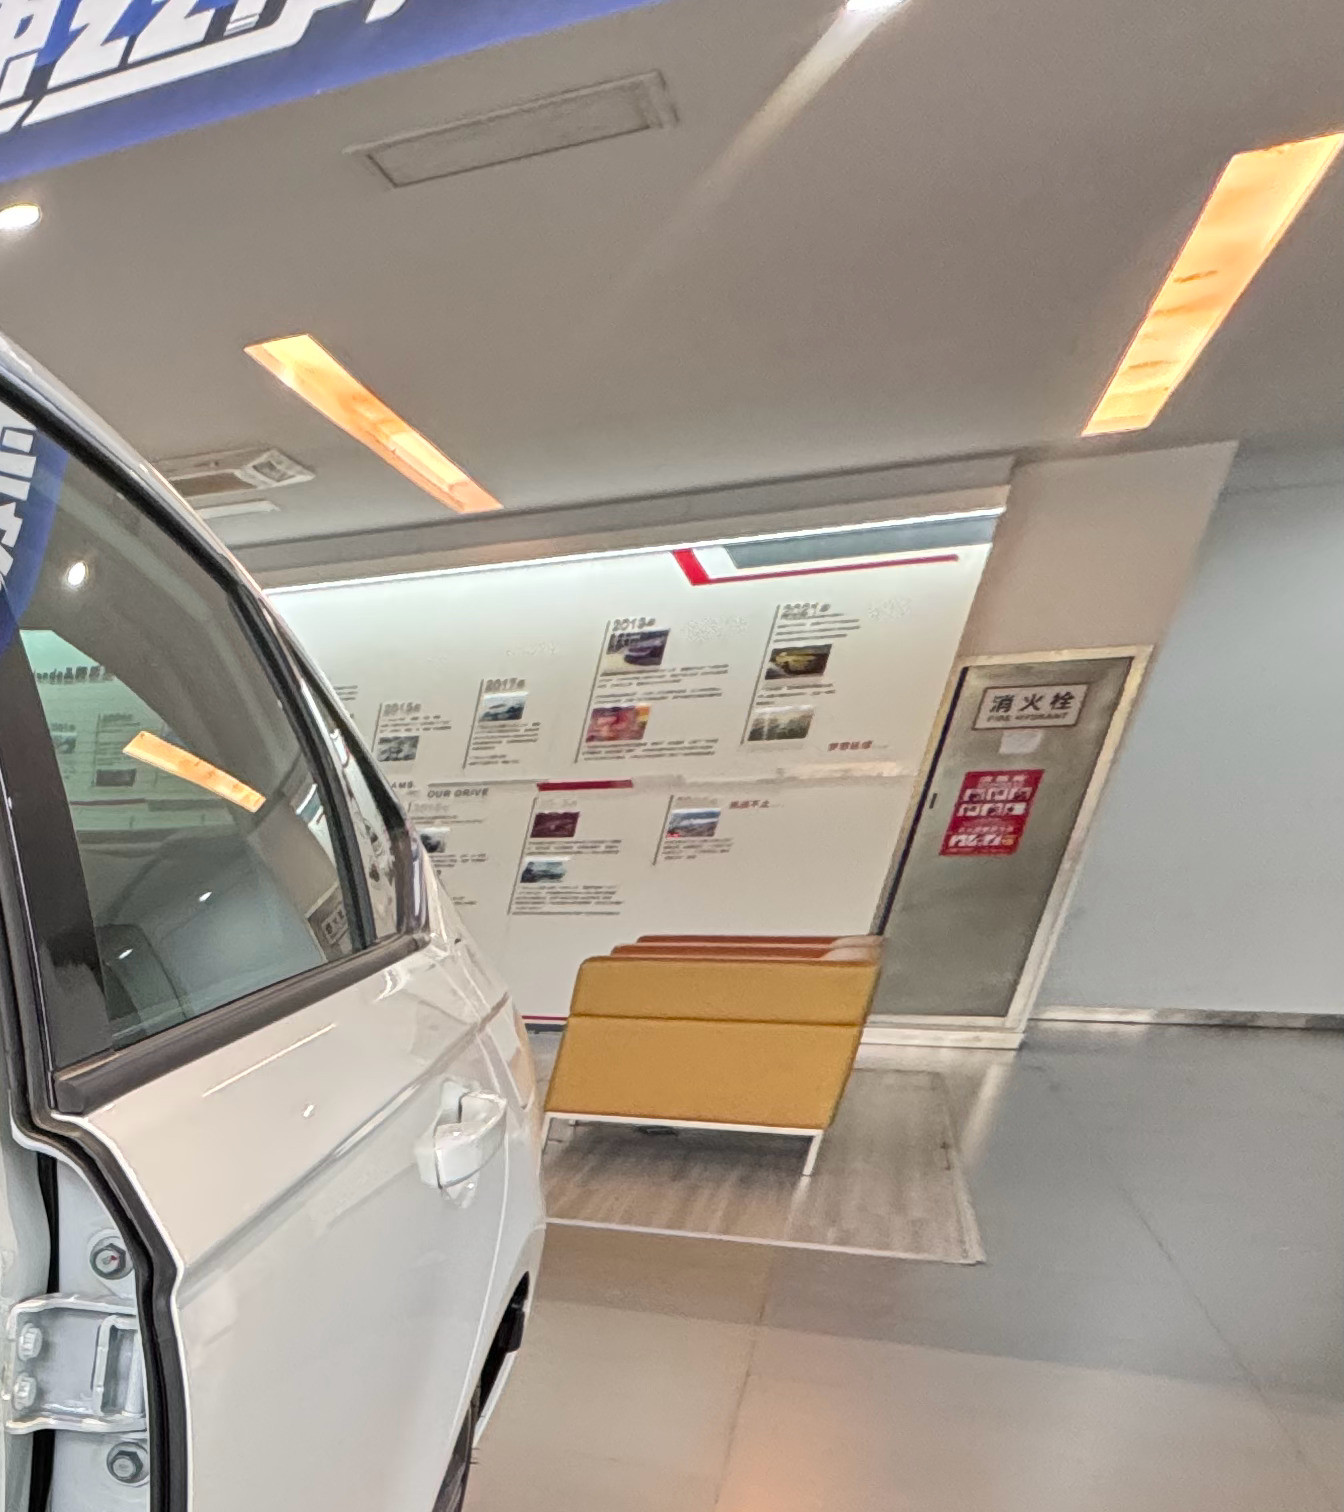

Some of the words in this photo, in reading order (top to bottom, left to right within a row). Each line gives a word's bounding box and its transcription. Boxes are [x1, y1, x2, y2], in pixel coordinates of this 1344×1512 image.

[988, 692, 1076, 714] 消火栓
[427, 789, 452, 799] OUR
[454, 787, 490, 798] DRIVE
